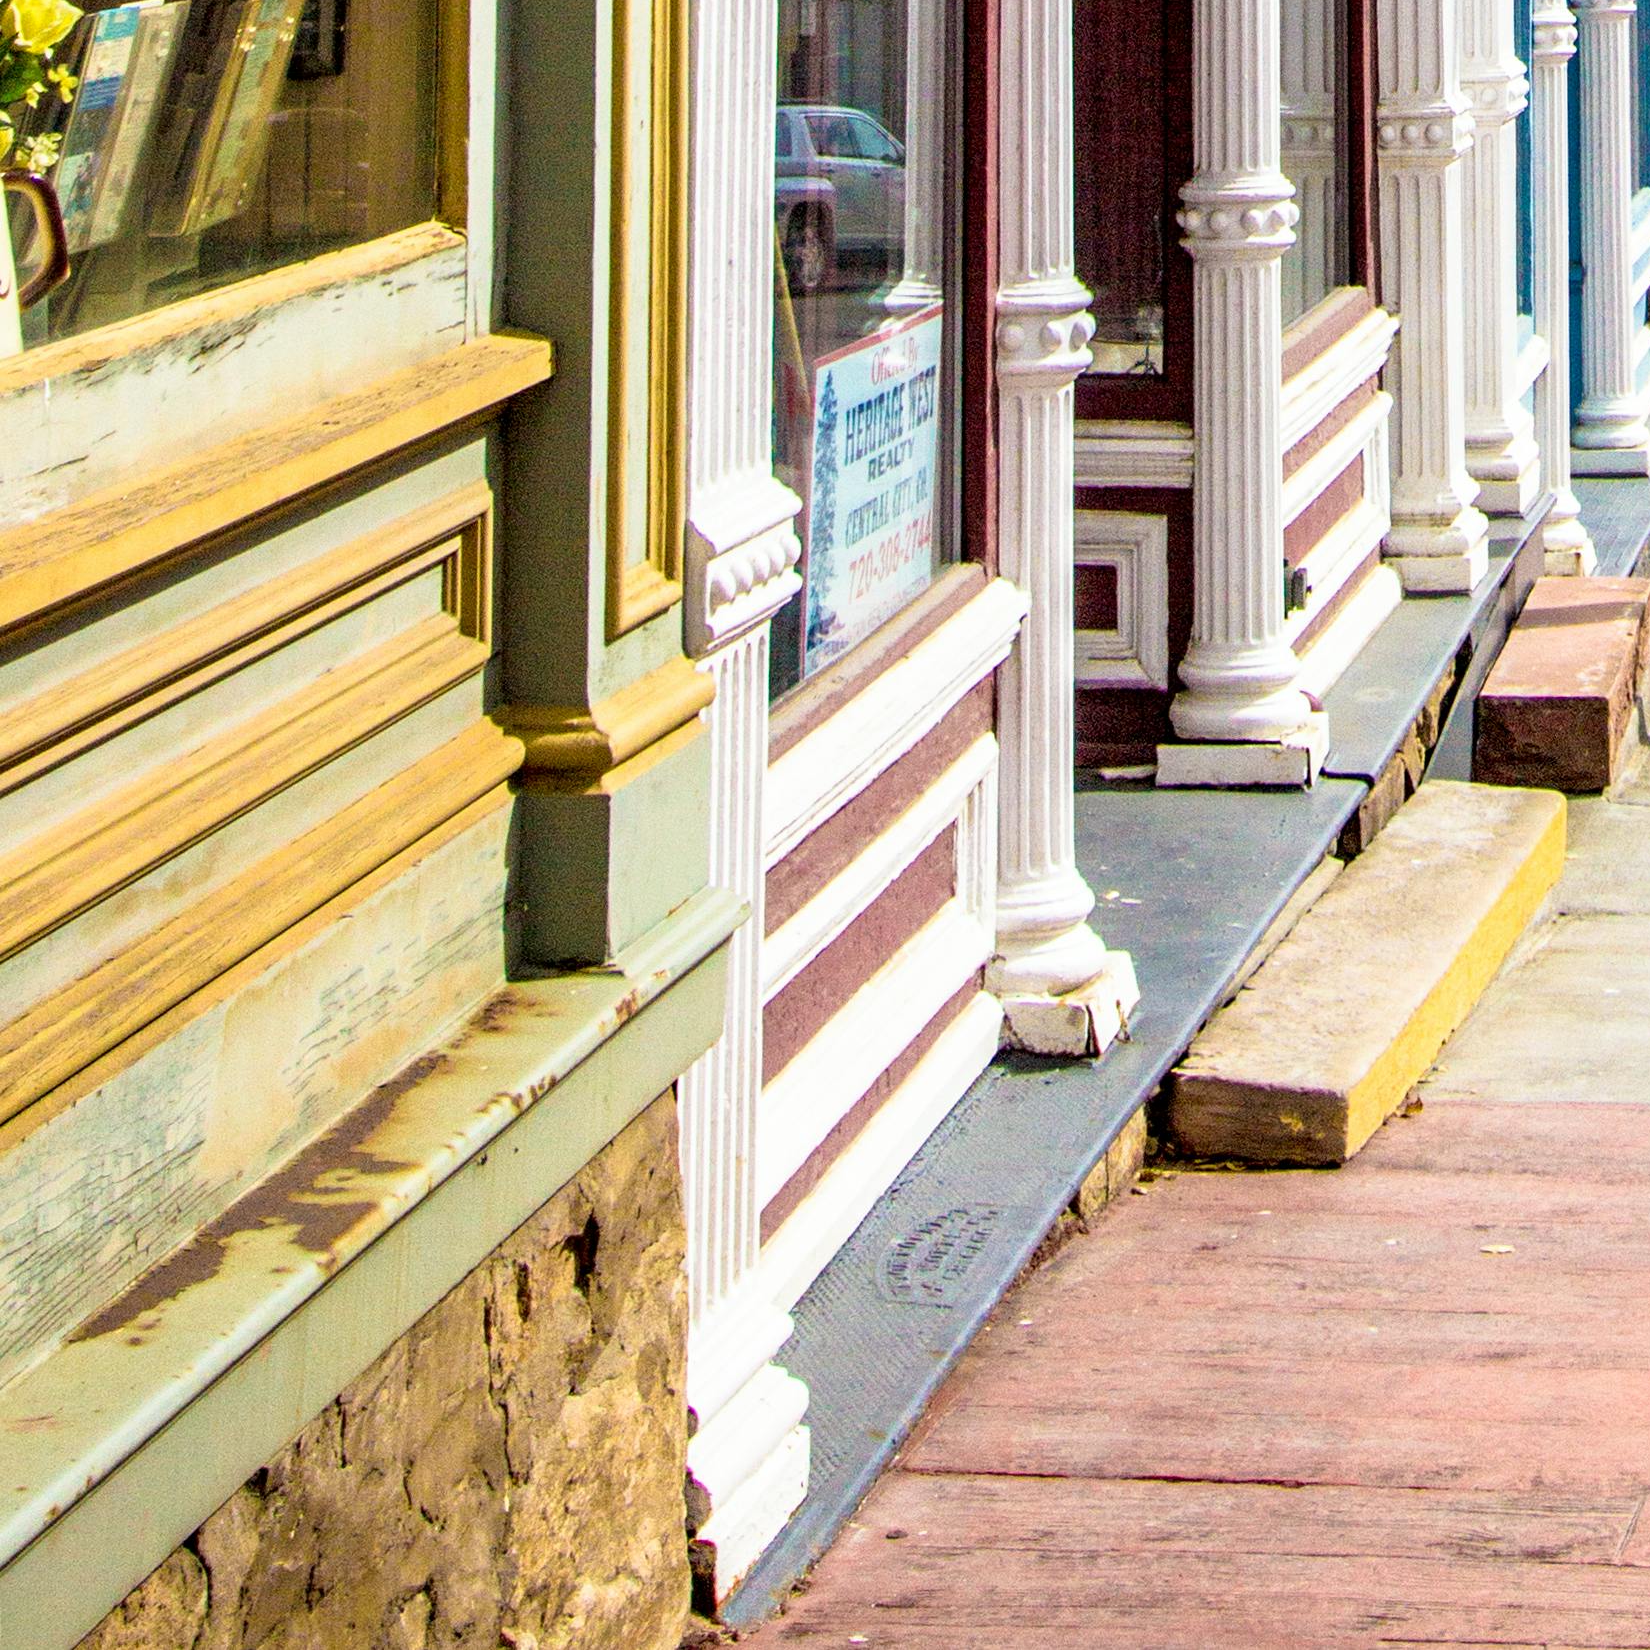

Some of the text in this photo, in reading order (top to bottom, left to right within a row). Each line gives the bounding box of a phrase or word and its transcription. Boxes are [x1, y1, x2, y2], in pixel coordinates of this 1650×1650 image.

[871, 339, 906, 385] Offed
[844, 364, 937, 467] HERITAGE WEST
[868, 437, 914, 482] REALTY
